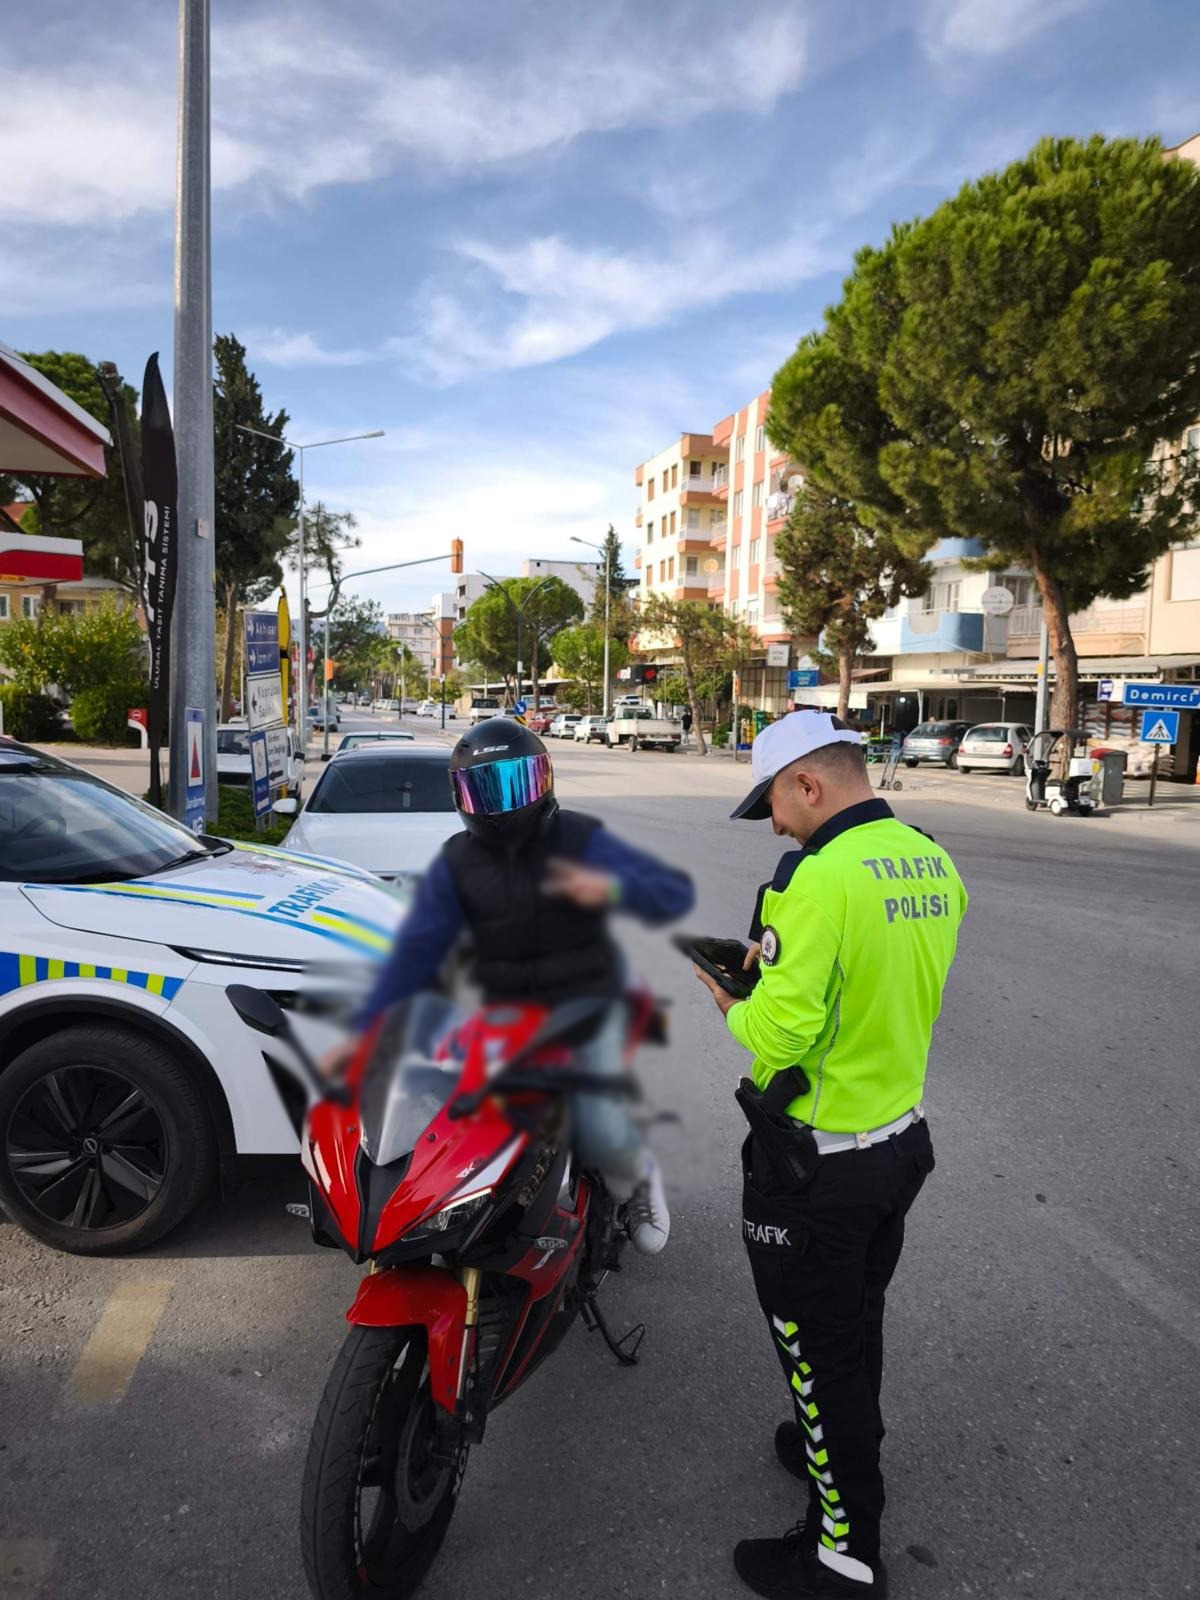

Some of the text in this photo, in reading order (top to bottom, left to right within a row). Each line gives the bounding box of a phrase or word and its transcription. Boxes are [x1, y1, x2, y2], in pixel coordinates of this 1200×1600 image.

[153, 645, 161, 689] ULUSAL
[158, 558, 167, 603] TANIMA
[1129, 689, 1194, 702] Demirci
[473, 745, 509, 756] LS2
[861, 856, 949, 880] TRAFİK
[267, 882, 340, 918] TRAFİK
[884, 893, 949, 923] POLİSİ
[743, 1218, 792, 1247] TRAFİK
